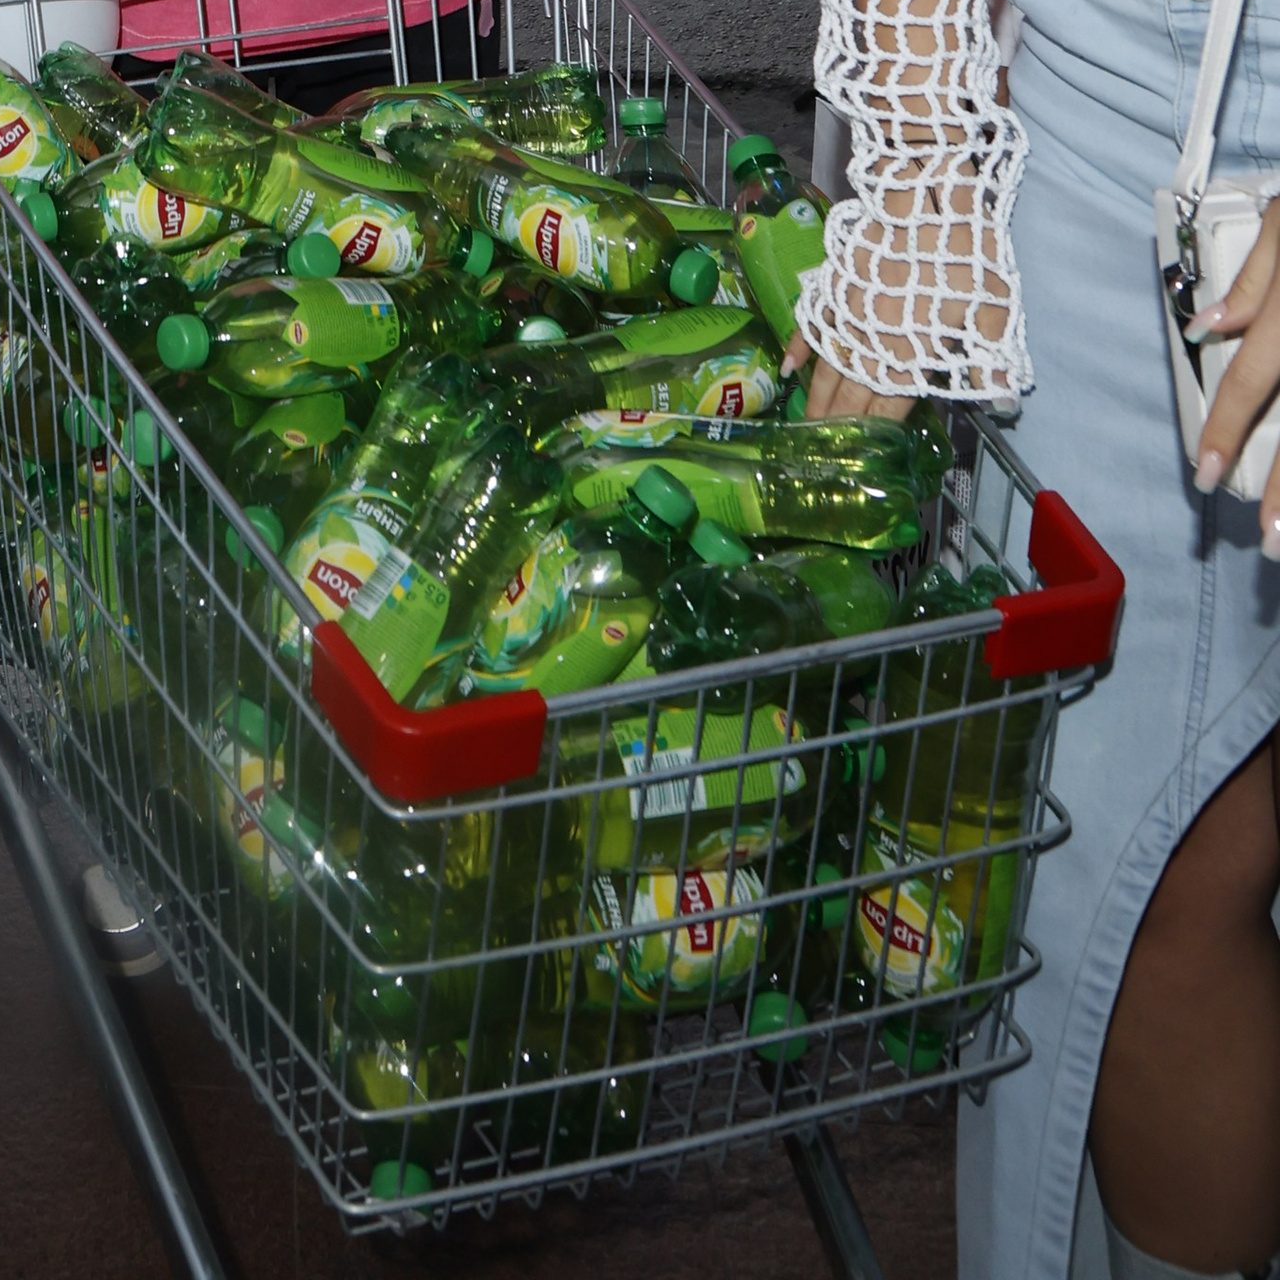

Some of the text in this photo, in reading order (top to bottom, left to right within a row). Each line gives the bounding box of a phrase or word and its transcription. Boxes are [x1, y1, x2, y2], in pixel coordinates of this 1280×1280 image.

[165, 194, 182, 236] Lipto
[346, 226, 378, 265] Lipto
[540, 215, 559, 268] Lipton
[866, 900, 926, 953] Lipon
